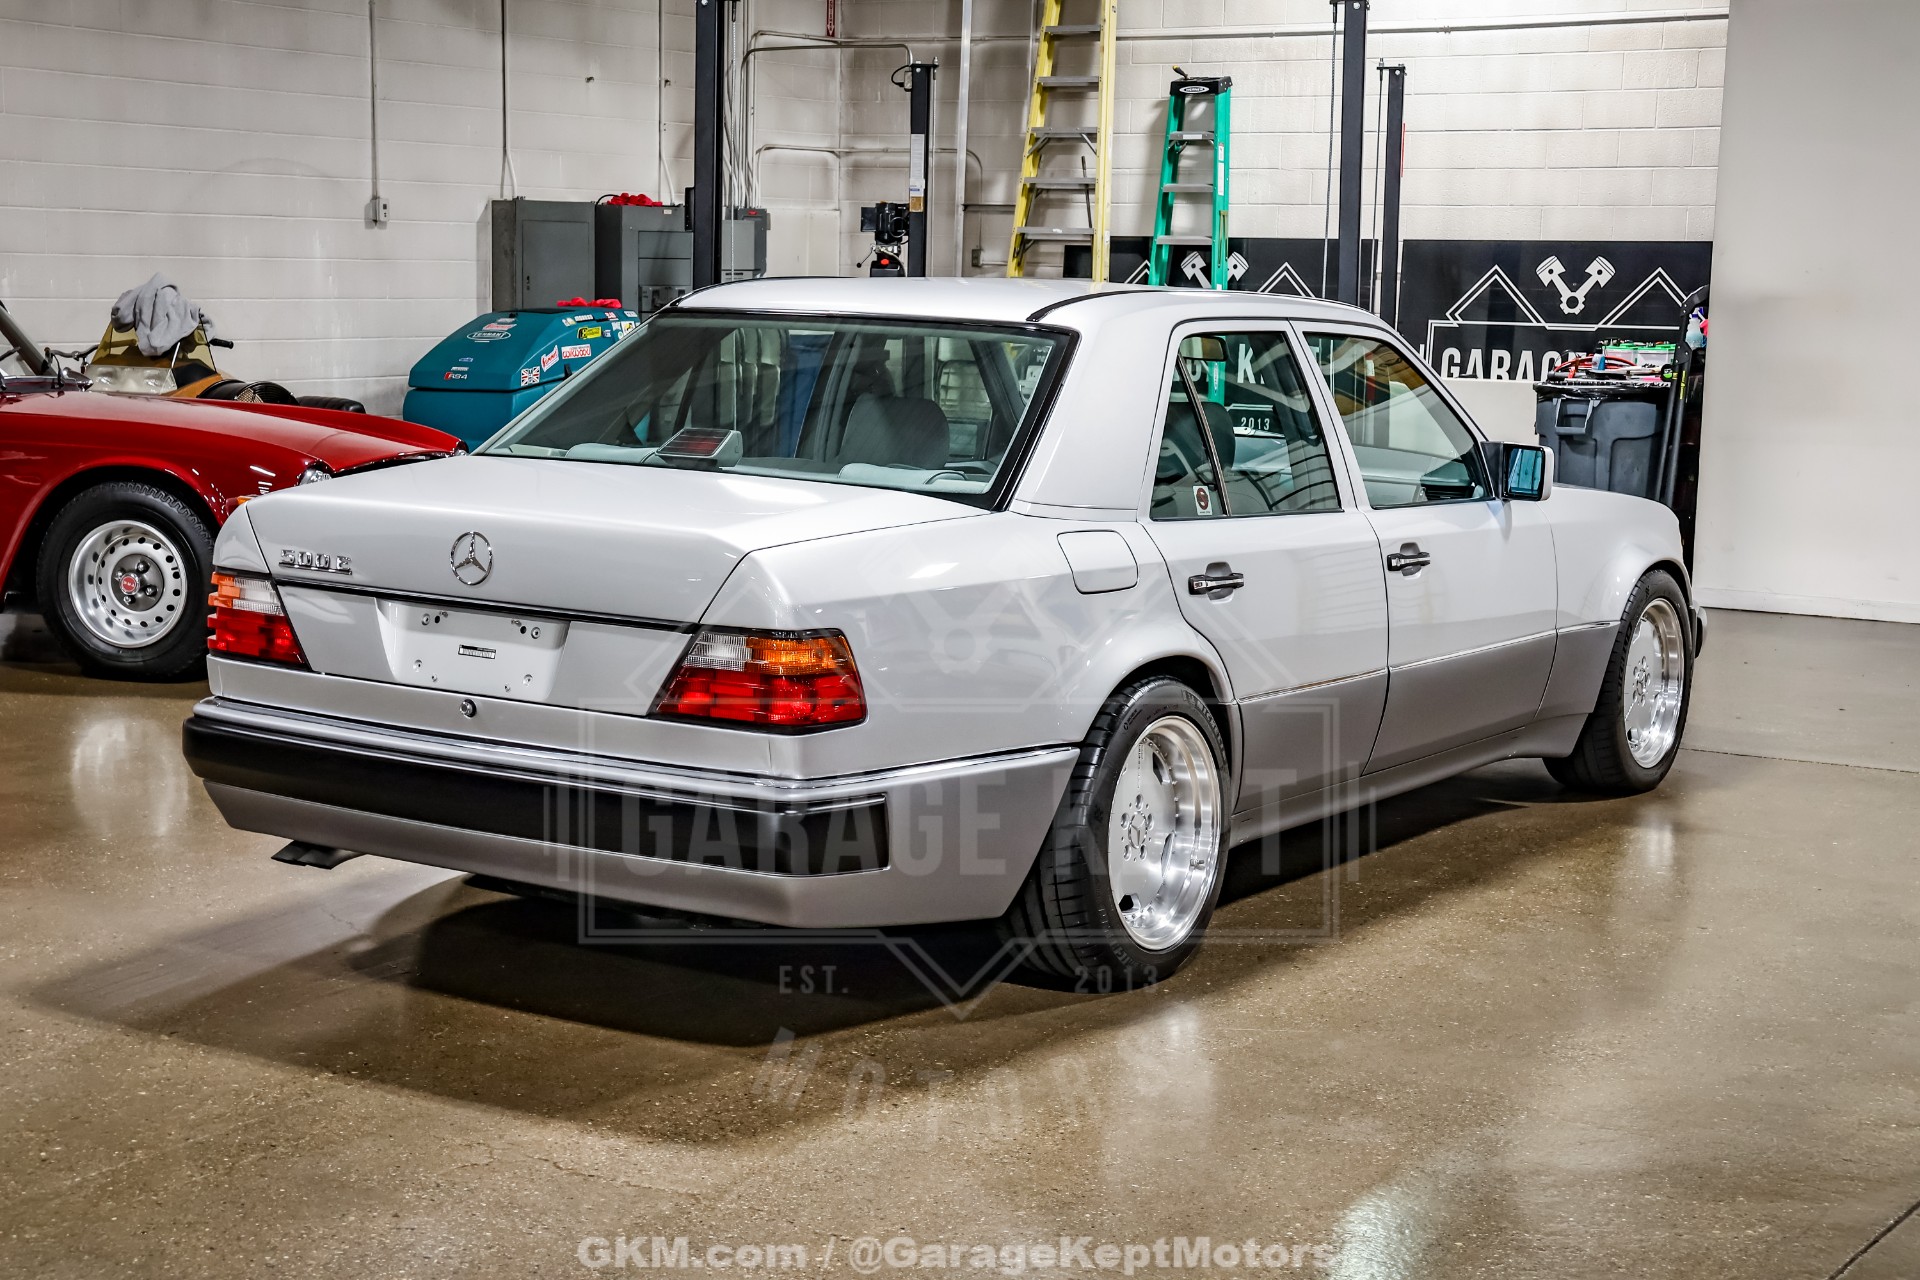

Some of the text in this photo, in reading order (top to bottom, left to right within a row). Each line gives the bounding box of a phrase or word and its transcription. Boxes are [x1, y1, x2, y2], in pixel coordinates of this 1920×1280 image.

[1440, 347, 1587, 382] GARAG
[1240, 416, 1270, 431] 2013
[280, 549, 353, 571] 500 E
